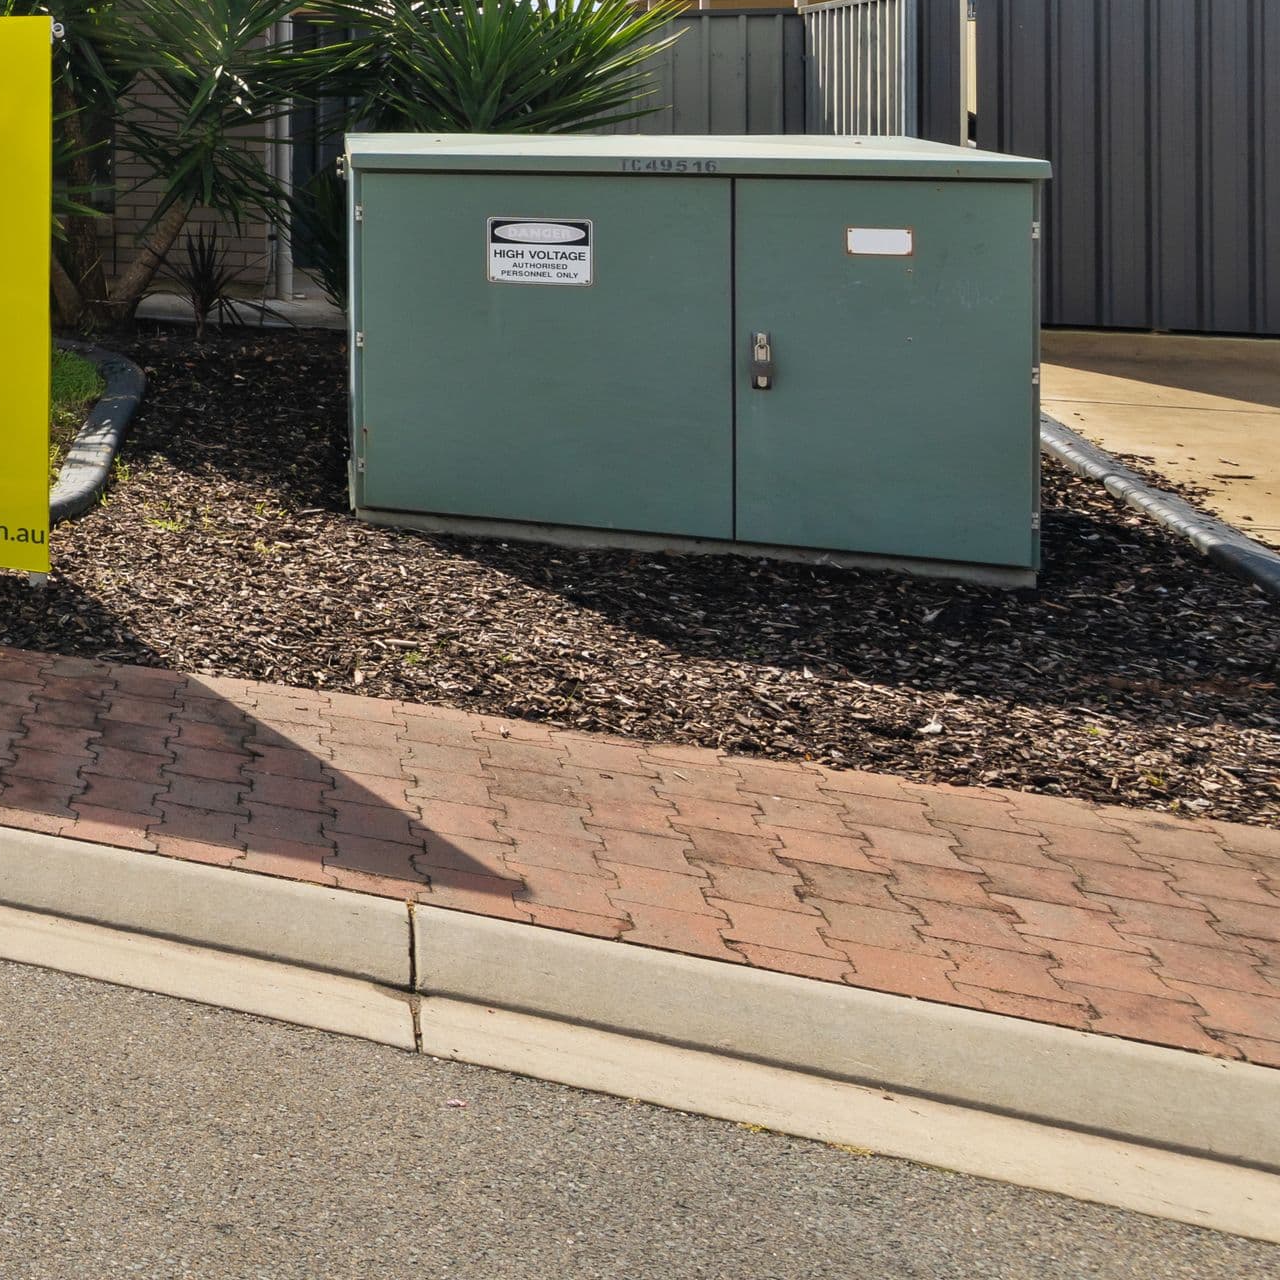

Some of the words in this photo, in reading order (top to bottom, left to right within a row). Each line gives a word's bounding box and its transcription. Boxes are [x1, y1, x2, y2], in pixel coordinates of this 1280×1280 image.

[493, 249, 524, 259] HIGH
[528, 250, 586, 261] VOLTAGE
[512, 262, 568, 270] AUTHORISED
[501, 270, 552, 278] PERSONNEL
